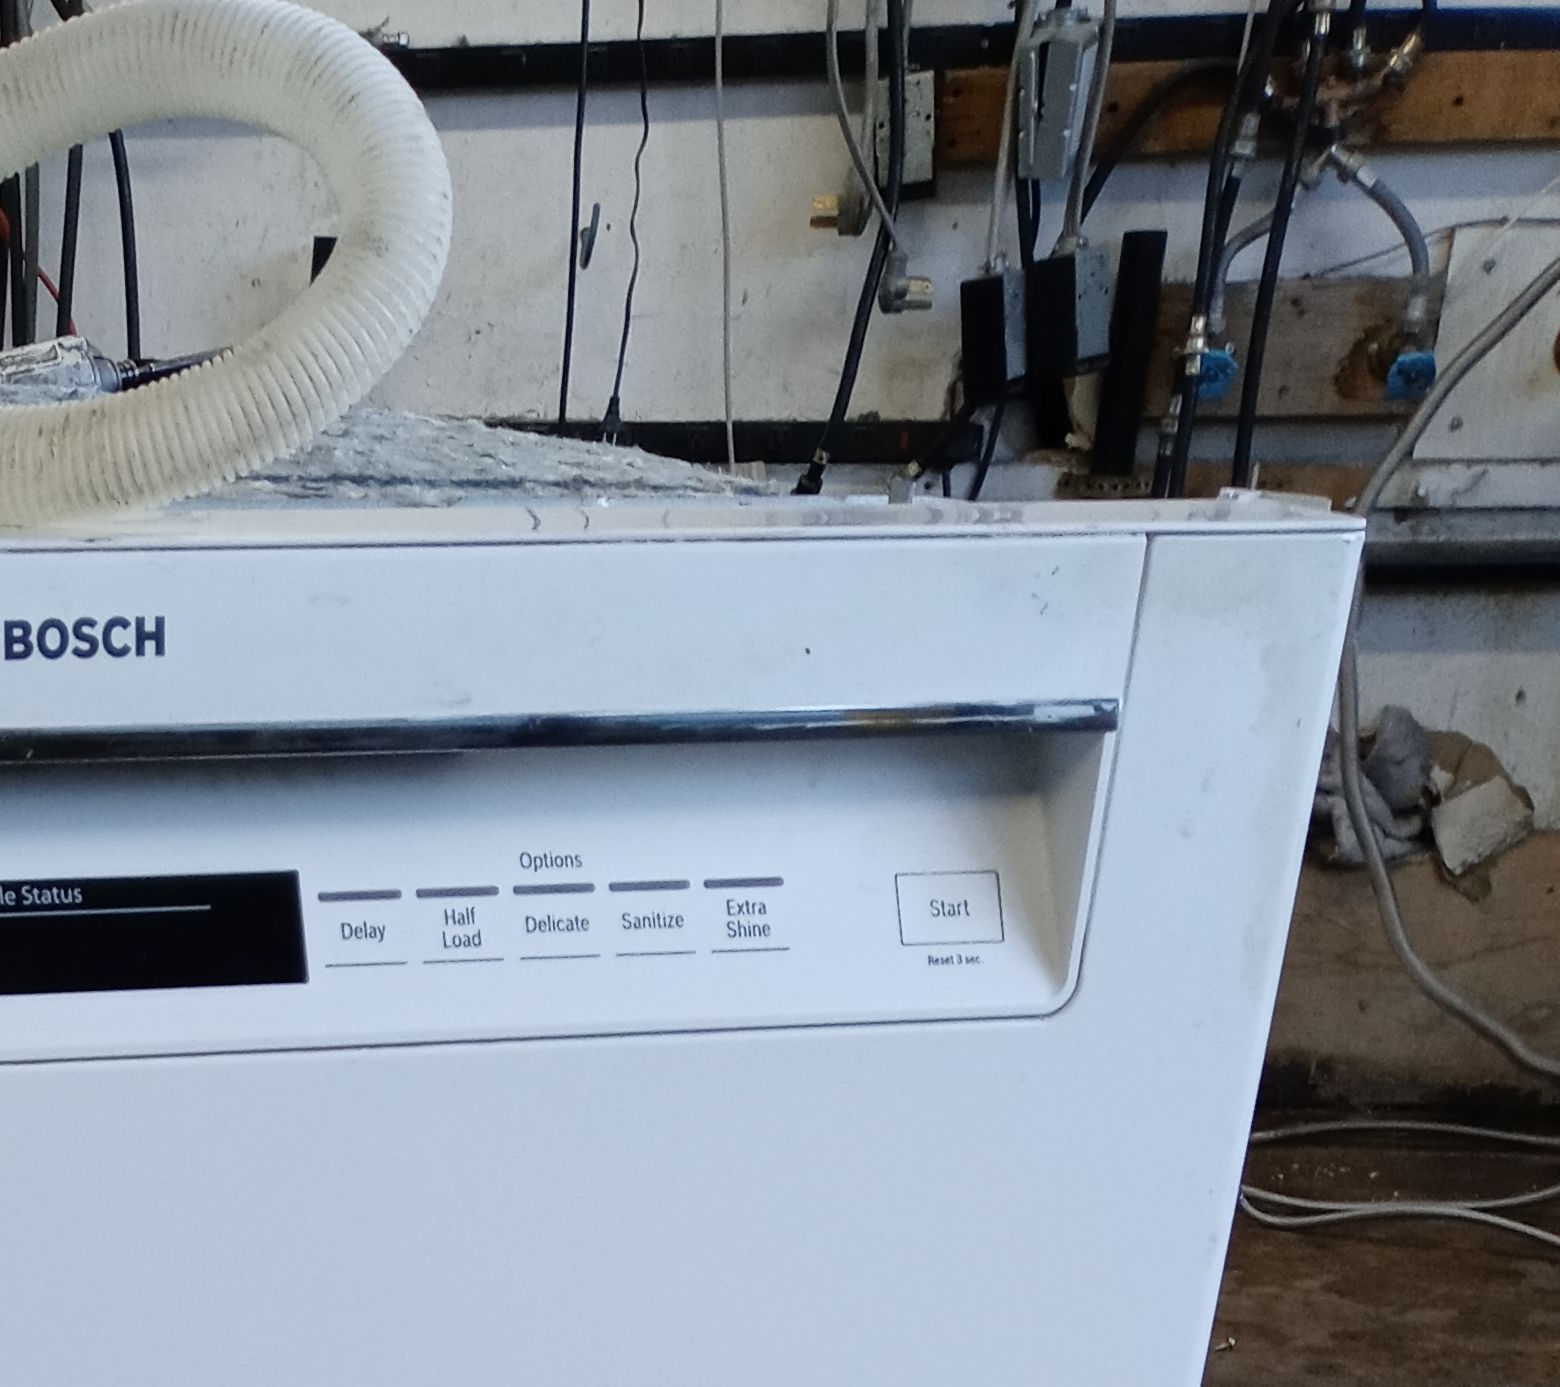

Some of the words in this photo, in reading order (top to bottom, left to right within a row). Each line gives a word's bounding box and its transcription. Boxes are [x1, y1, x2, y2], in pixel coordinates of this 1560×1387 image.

[4, 616, 166, 660] BOSCH
[520, 852, 582, 873] Options
[21, 885, 83, 906] Status
[444, 907, 476, 926] Half
[727, 899, 767, 917] Extra
[930, 899, 970, 918] Start
[525, 914, 590, 934] Delicate
[622, 912, 685, 930] Sanitize
[727, 919, 771, 938] Shine
[341, 921, 386, 943] Delay
[443, 929, 482, 949] Load
[928, 954, 954, 967] Reset
